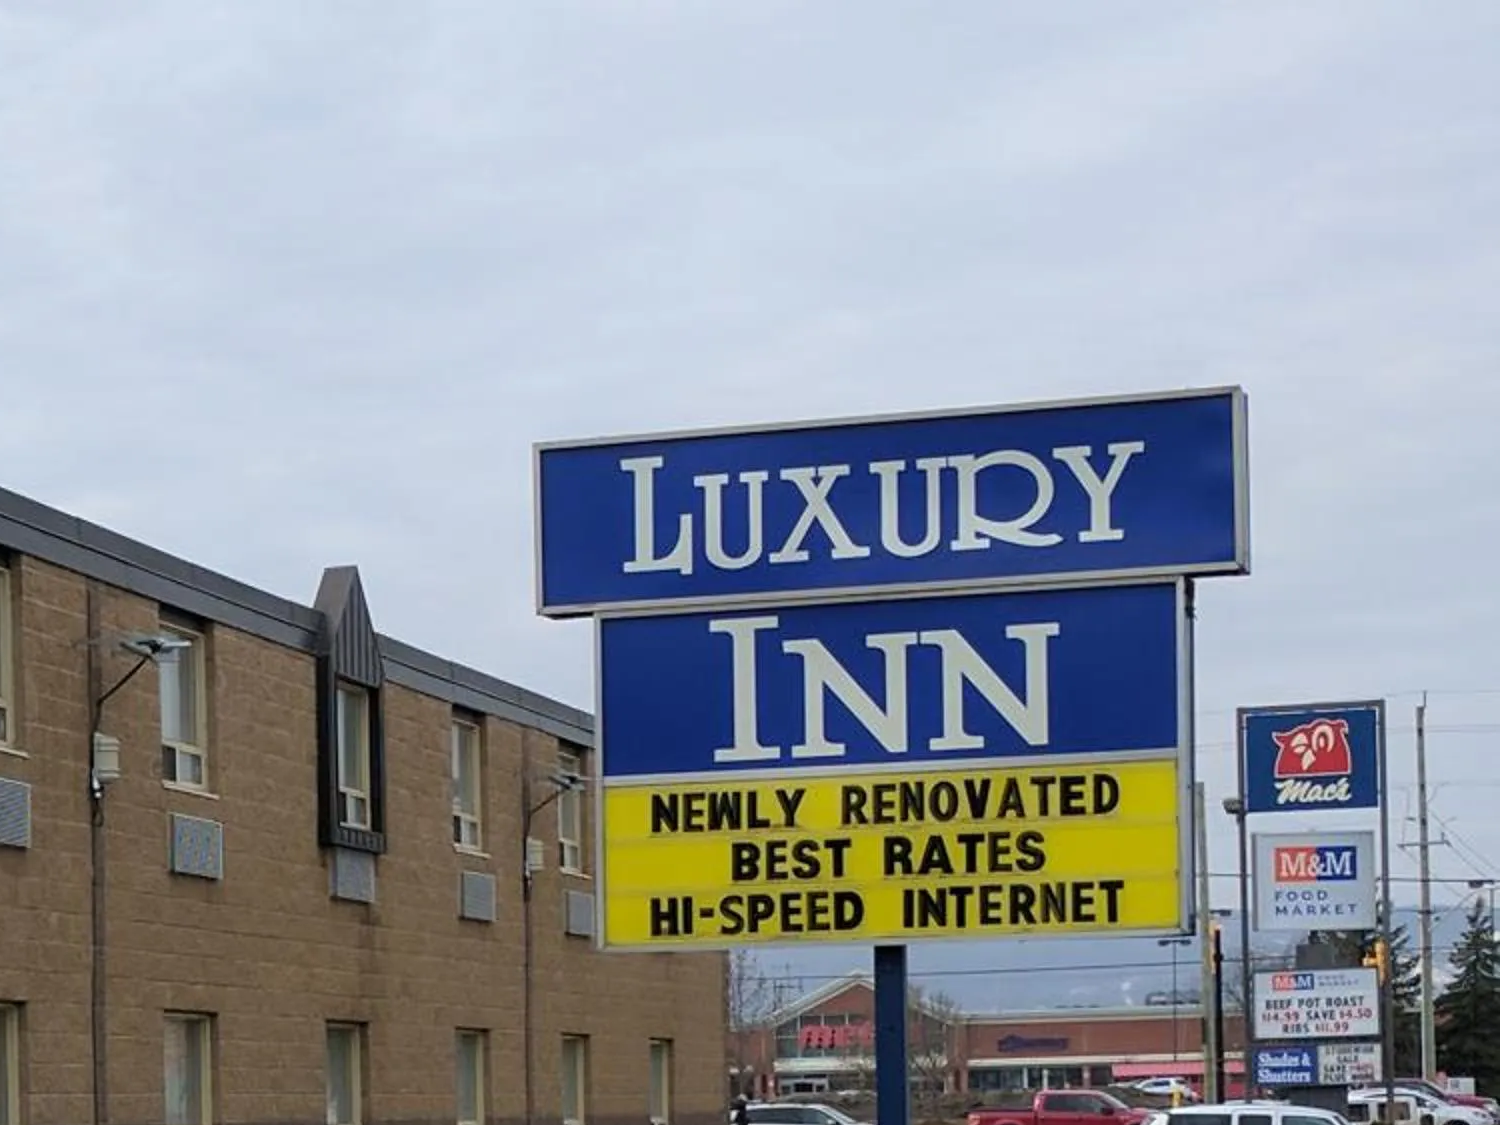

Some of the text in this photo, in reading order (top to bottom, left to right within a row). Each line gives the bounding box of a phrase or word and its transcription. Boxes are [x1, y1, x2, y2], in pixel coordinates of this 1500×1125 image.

[620, 440, 1145, 575] LUXURY
[708, 615, 1060, 763] INN
[1274, 778, 1353, 804] Mac's
[649, 773, 1121, 834] NEWLY RENOVATED
[731, 831, 1047, 882] BEST RATES
[1278, 850, 1353, 878] M&M
[1274, 889, 1329, 903] FOOD
[649, 880, 1126, 938] HI-SPEED INTERNET
[1274, 903, 1358, 917] MARKET
[1265, 995, 1365, 1010] BEEF POT ROAST
[1306, 1009, 1337, 1021] SAVE
[1282, 1022, 1310, 1034] RIBS
[1257, 1051, 1300, 1067] Shades
[1257, 1068, 1312, 1083] Shutters
